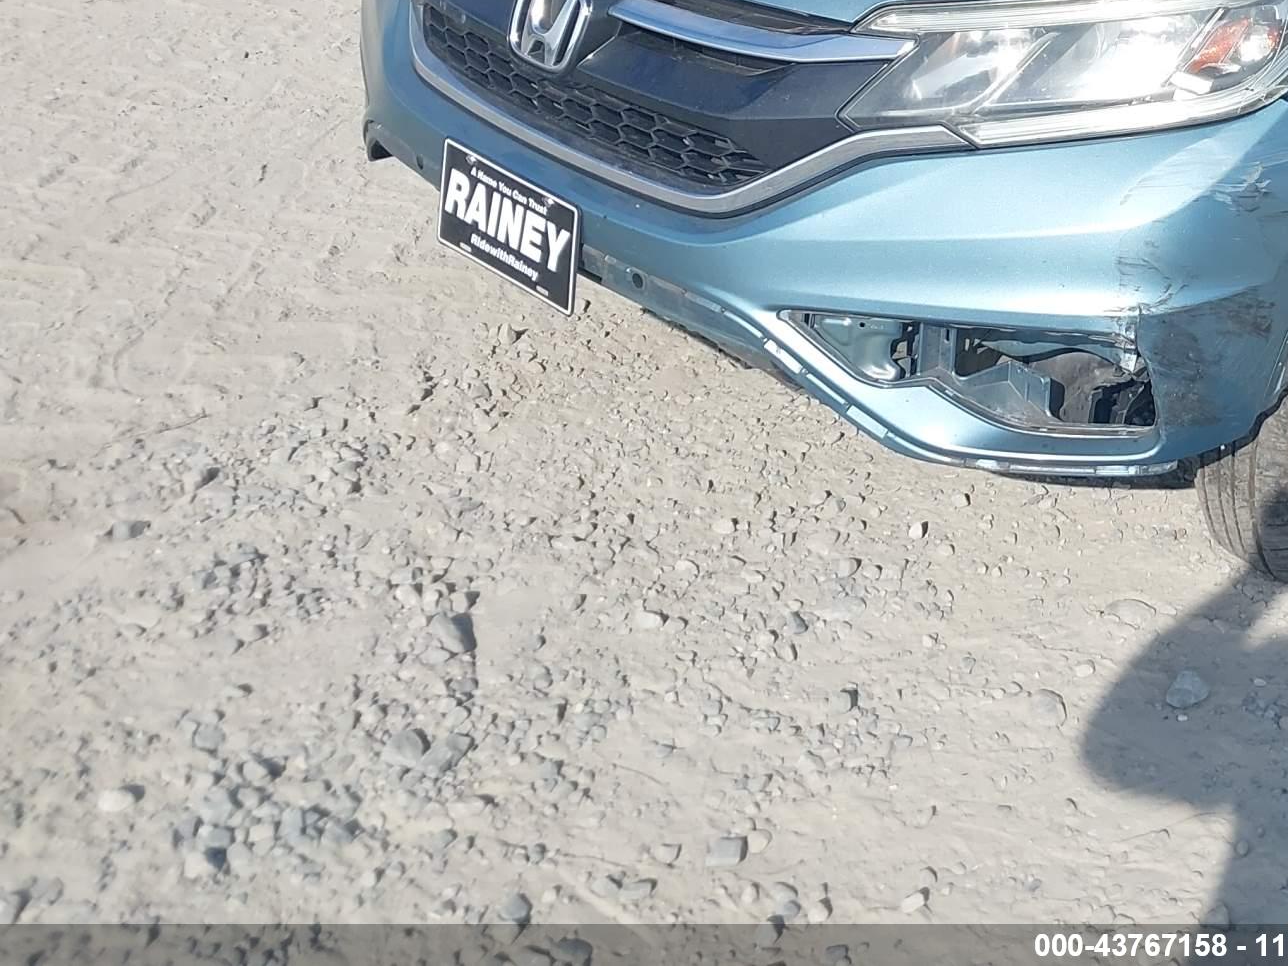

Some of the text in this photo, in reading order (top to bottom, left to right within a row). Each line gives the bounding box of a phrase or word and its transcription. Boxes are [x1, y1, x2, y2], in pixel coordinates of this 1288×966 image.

[444, 168, 571, 273] RAINEY
[470, 166, 548, 215] A Name You Can Trust
